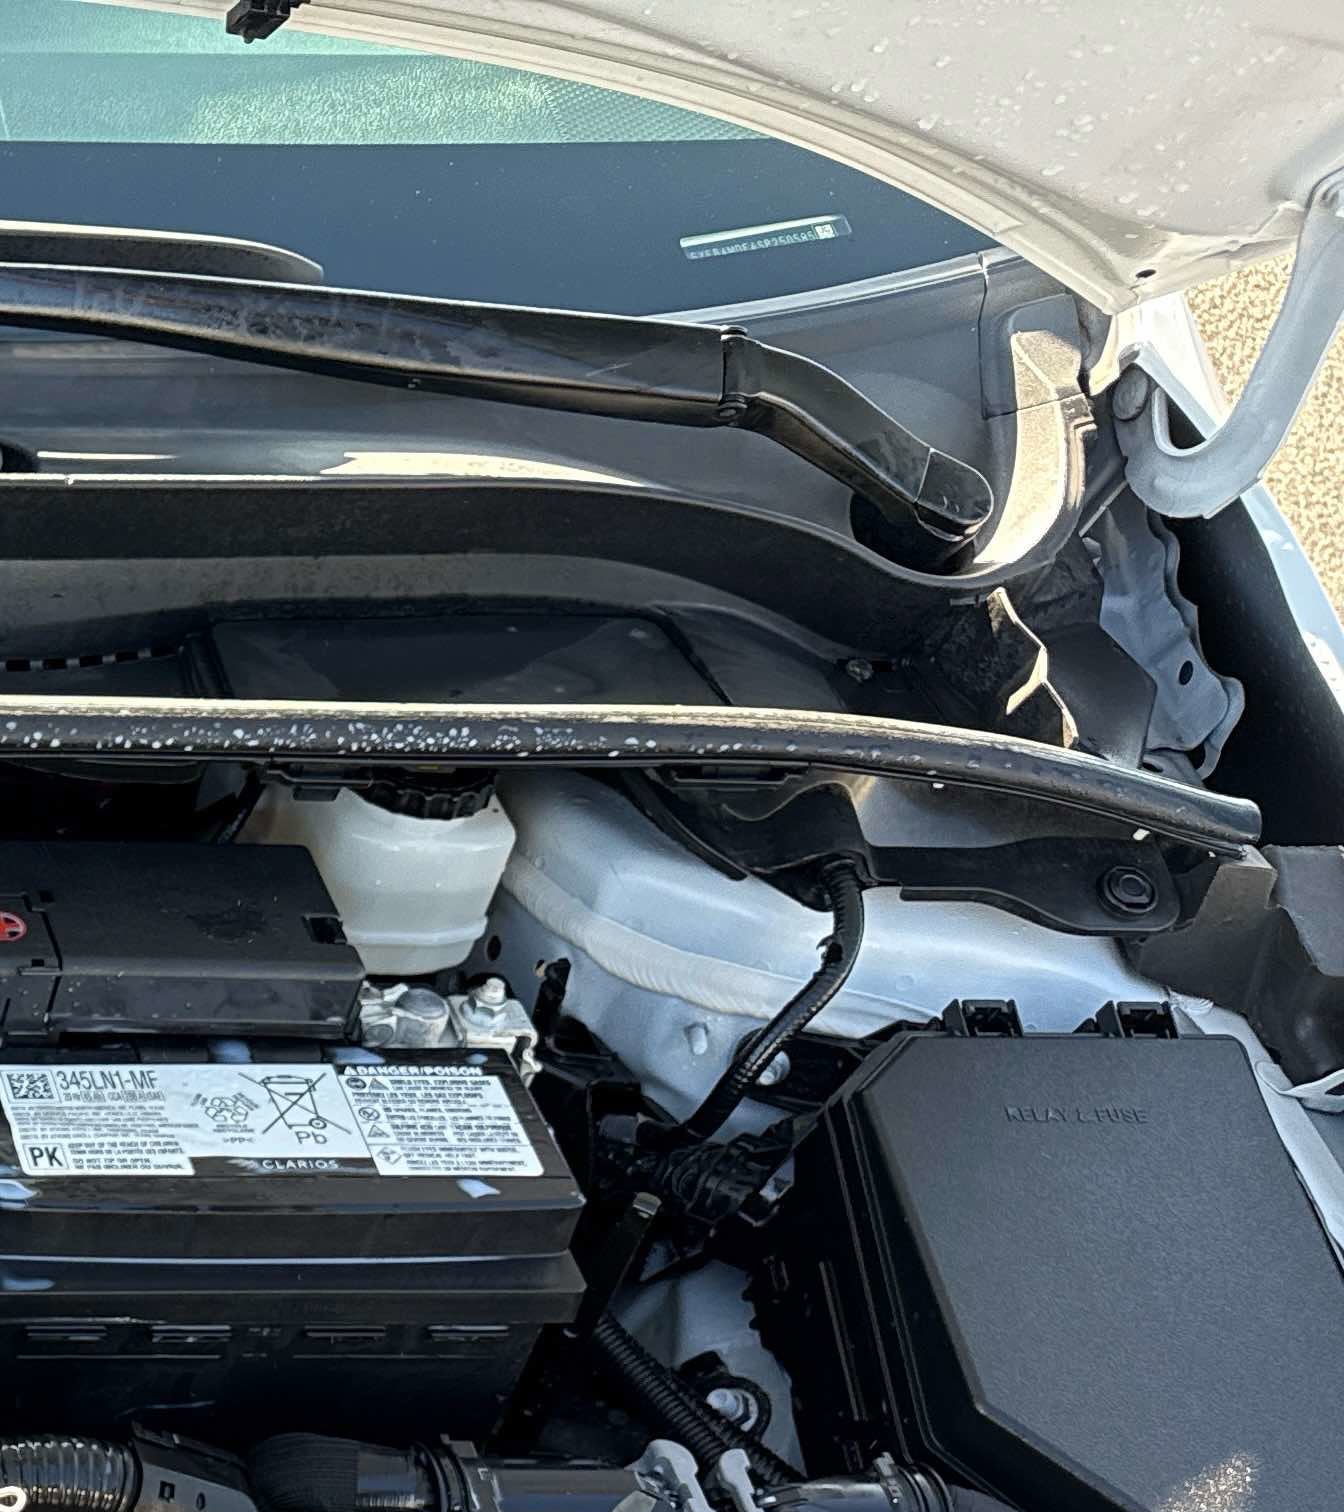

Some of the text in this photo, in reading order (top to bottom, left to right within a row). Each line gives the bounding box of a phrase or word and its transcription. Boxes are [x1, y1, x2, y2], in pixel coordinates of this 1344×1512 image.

[59, 1070, 158, 1090] 345LN1-MF
[1094, 1105, 1148, 1123] FUSE
[294, 1131, 328, 1145] Pb
[28, 1147, 63, 1167] PK
[262, 1159, 339, 1169] CLARIOS
